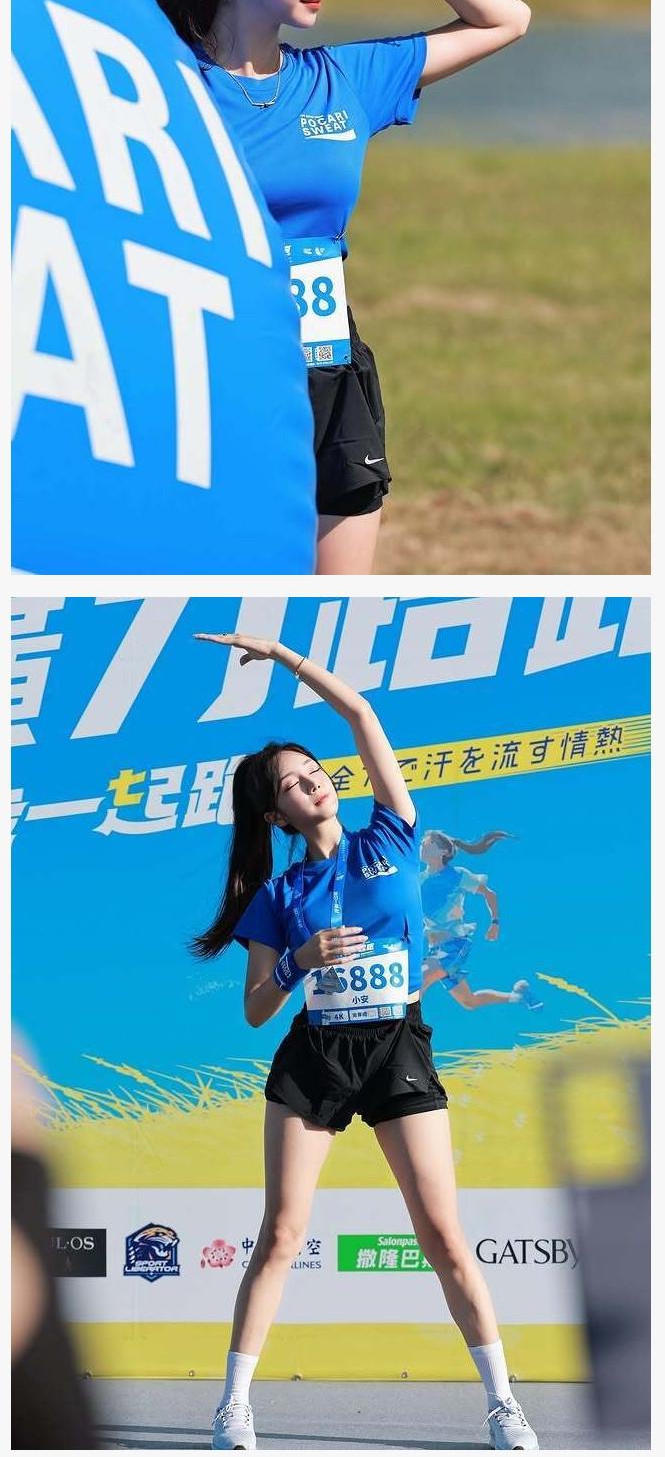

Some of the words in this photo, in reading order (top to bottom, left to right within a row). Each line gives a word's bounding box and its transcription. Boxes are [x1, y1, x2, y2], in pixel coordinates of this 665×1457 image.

[300, 110, 349, 128] POCARI
[302, 120, 347, 136] SWEAT
[330, 723, 624, 793] 全で汗を流す情熱
[311, 963, 404, 995] 16888
[352, 995, 369, 1005] 小安
[135, 1260, 169, 1268] SPORT
